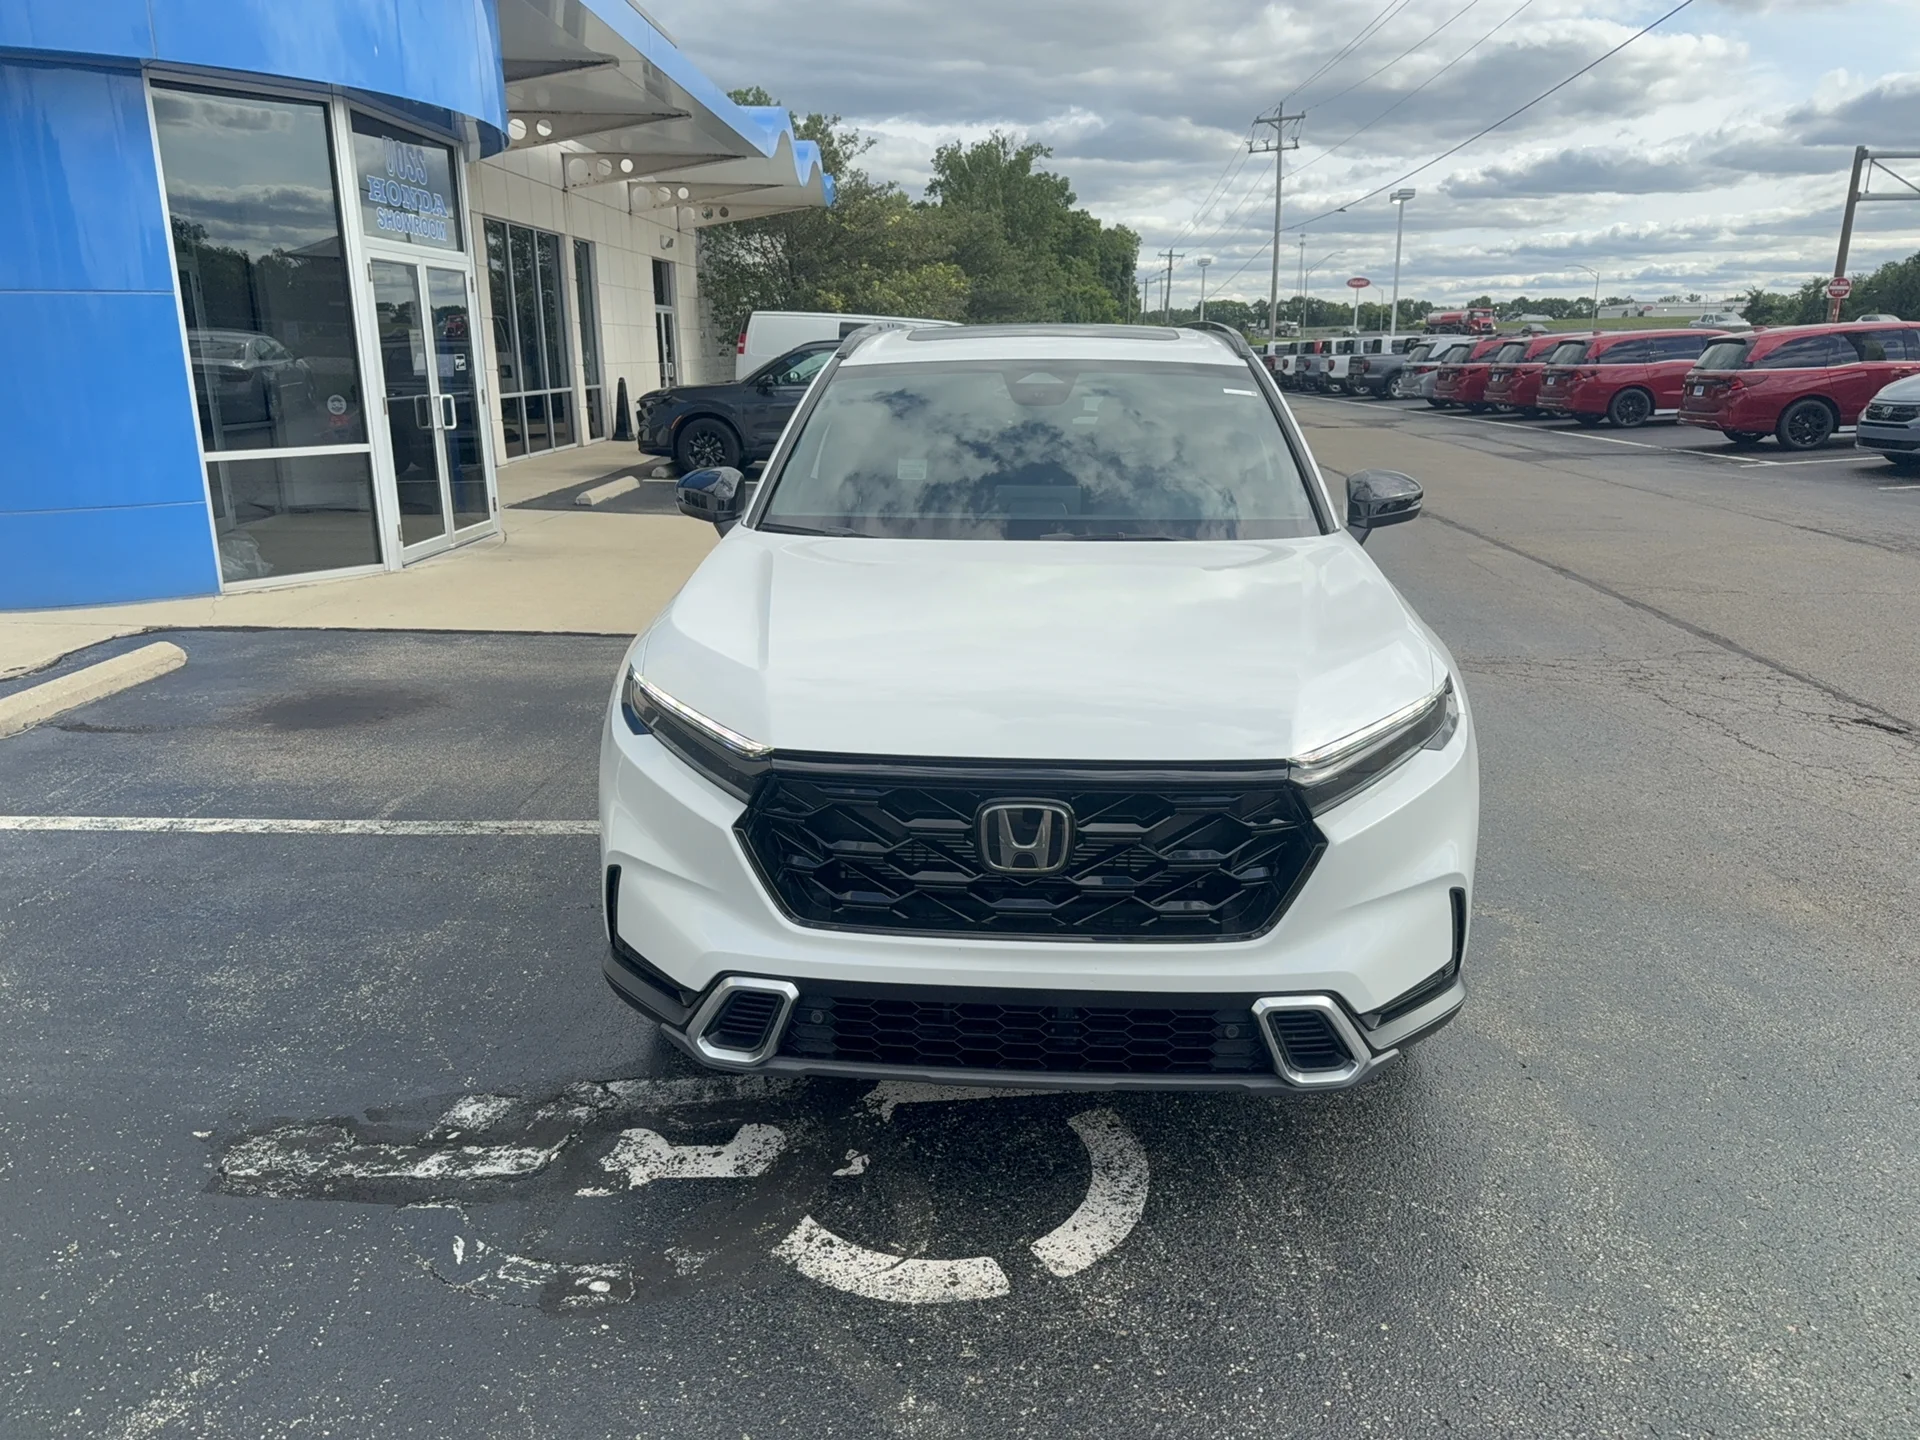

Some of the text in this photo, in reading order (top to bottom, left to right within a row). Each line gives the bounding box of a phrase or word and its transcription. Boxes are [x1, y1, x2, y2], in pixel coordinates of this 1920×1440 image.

[382, 135, 427, 186] VOSS
[367, 175, 448, 218] HONDA
[376, 206, 447, 241] SHOWROOM
